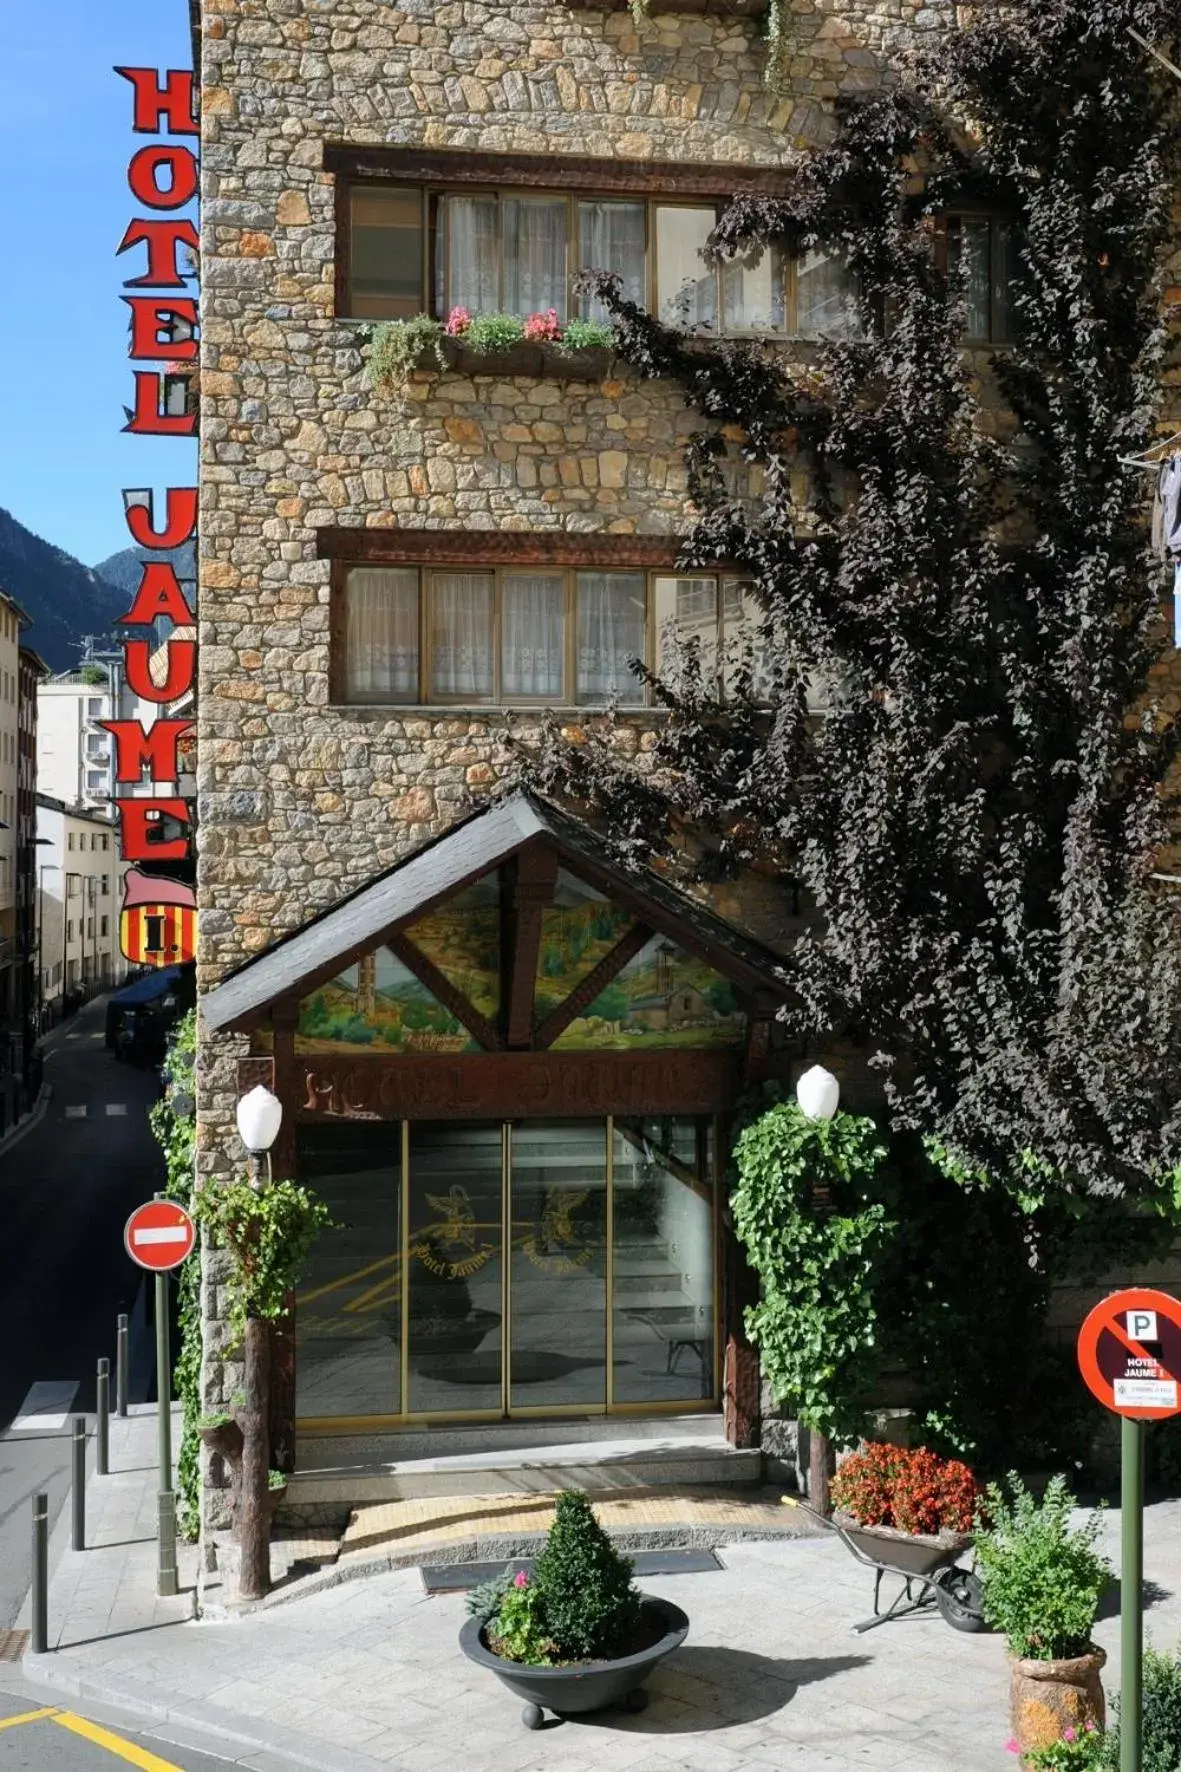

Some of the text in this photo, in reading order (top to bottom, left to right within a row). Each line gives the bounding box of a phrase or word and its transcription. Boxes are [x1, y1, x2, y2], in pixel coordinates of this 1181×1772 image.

[112, 65, 200, 437] HOTEL
[94, 487, 199, 862] JAUME
[1134, 1315, 1151, 1336] P
[1124, 1368, 1157, 1378] JAUME
[1127, 1358, 1160, 1367] HOTEL
